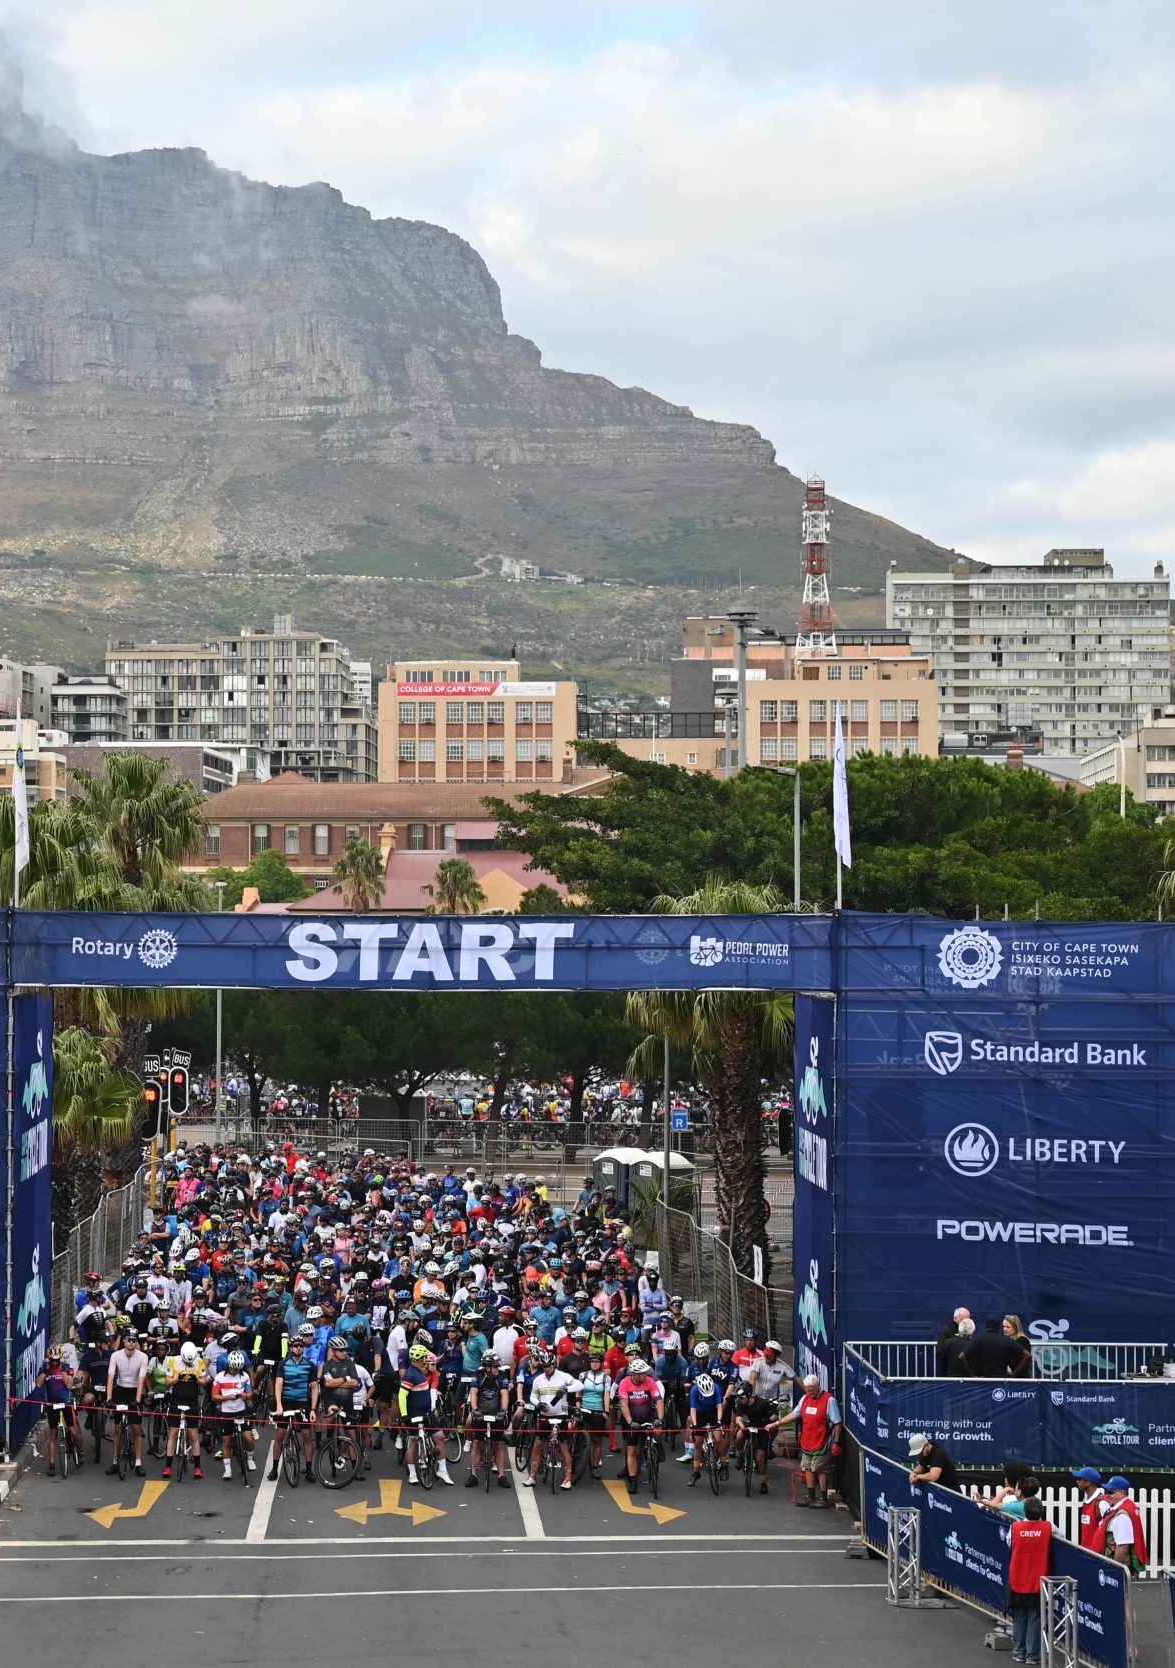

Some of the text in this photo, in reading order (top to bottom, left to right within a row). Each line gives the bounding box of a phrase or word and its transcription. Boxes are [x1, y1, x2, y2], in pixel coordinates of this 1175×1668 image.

[72, 937, 134, 959] Rotary
[286, 922, 574, 982] START
[726, 941, 789, 957] PEDAL POWER
[1012, 942, 1140, 954] CITY OF CAPE TOWN
[725, 956, 789, 966] ASSOCIATION
[1011, 954, 1130, 966] ISIXEKO SASEKAPA
[1010, 966, 1112, 978] STAD KAAPSTAD
[970, 1039, 1147, 1066] Standard Bank
[175, 1054, 189, 1066] BUS
[676, 1119, 683, 1128] R
[1009, 1138, 1126, 1164] LIBERTY
[937, 1219, 1128, 1246] POWERADE
[711, 1368, 728, 1380] sky
[898, 1417, 949, 1429] Partnering
[952, 1418, 973, 1428] with
[898, 1430, 994, 1441] cliets for Growth.
[1102, 1435, 1121, 1445] CYCLE
[1123, 1435, 1140, 1445] TOUR
